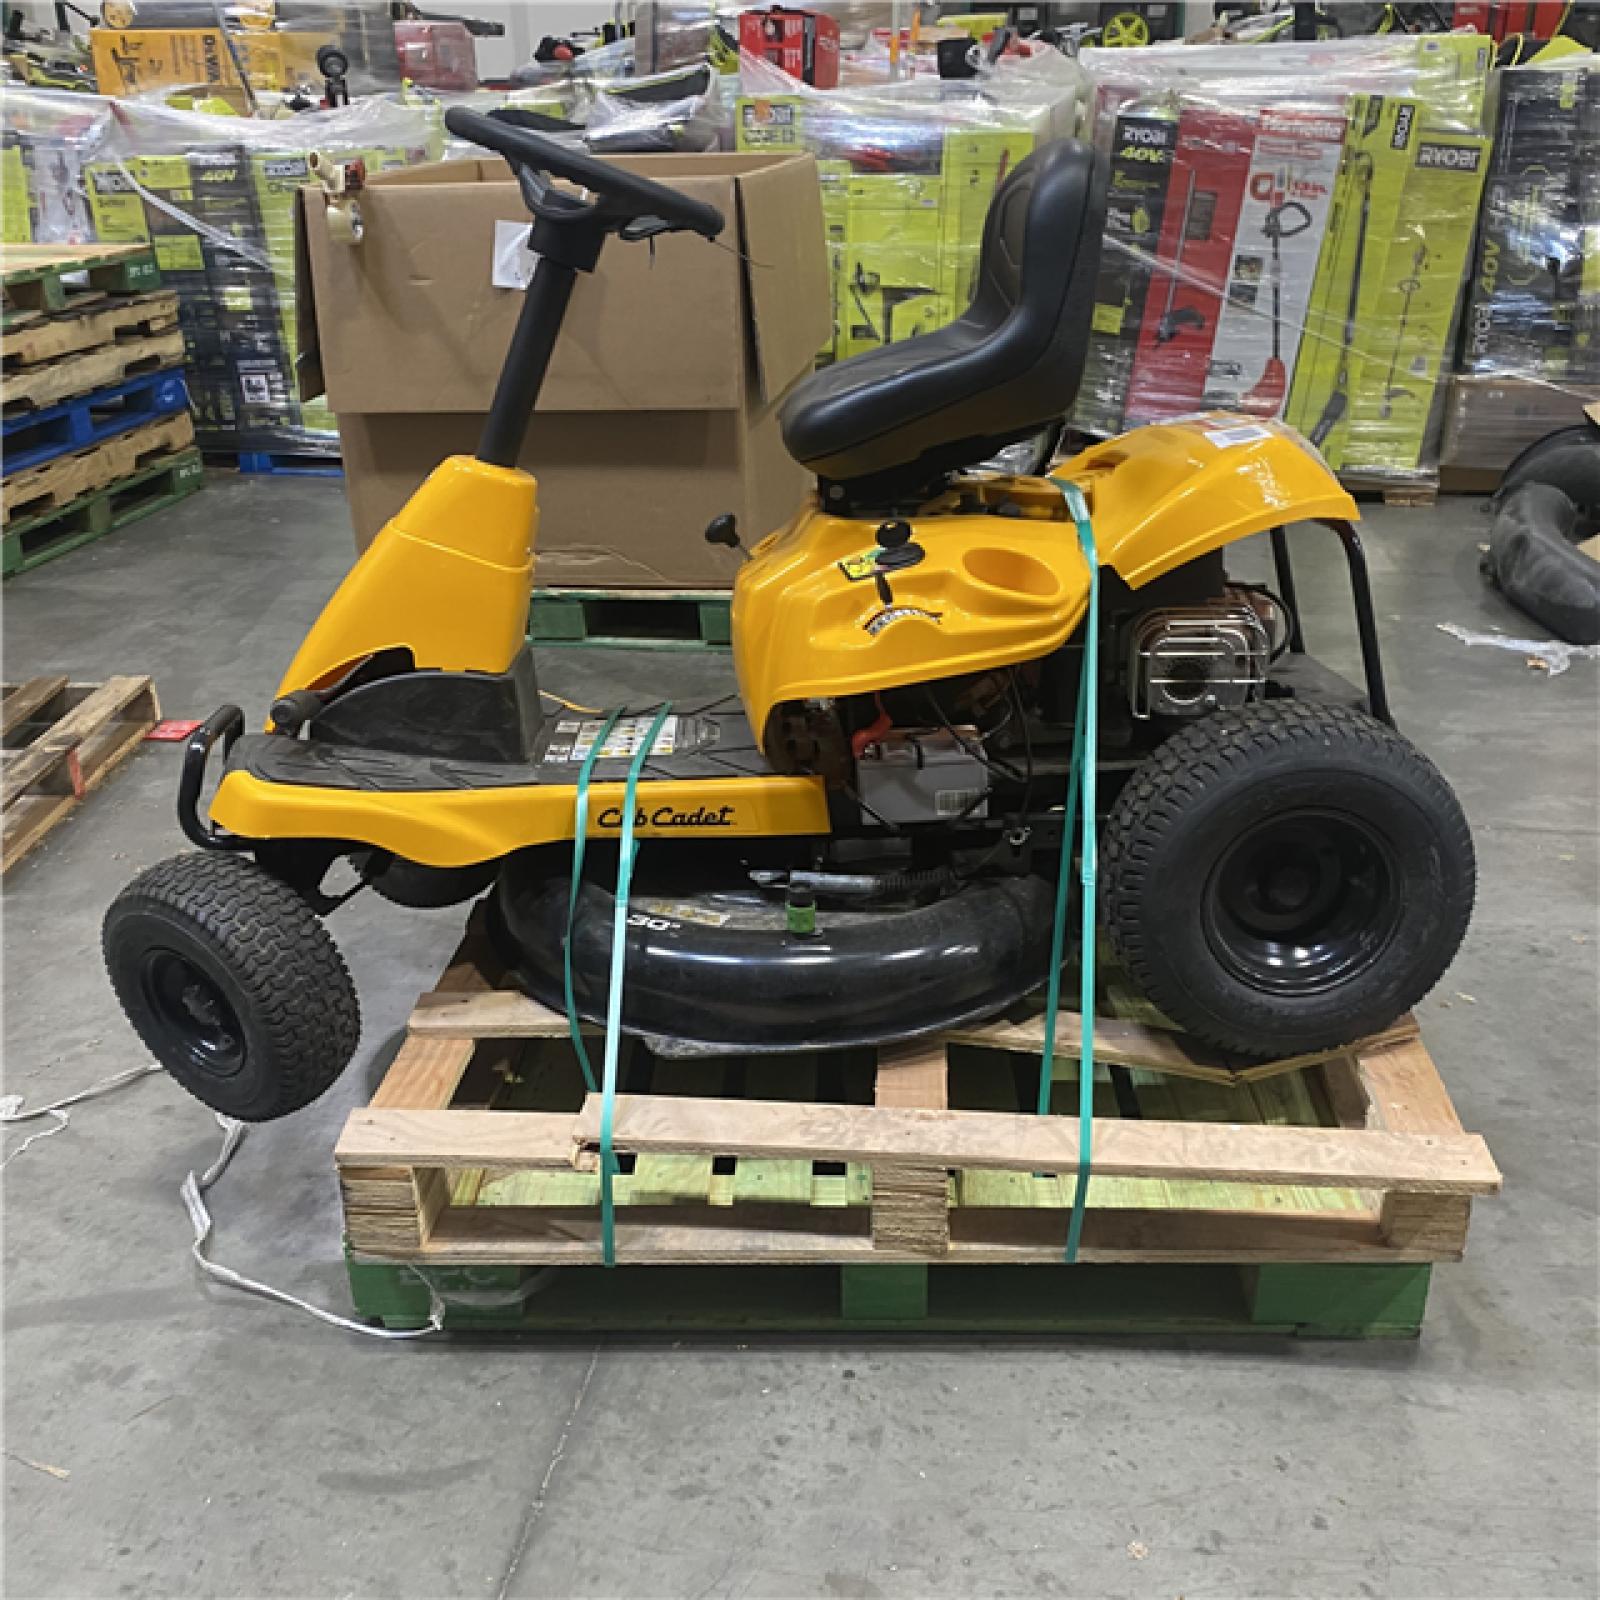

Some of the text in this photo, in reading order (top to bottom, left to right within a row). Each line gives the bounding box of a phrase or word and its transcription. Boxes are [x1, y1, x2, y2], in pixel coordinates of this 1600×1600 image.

[1480, 240, 1501, 295] 40V
[597, 804, 736, 827] Cb Cadet
